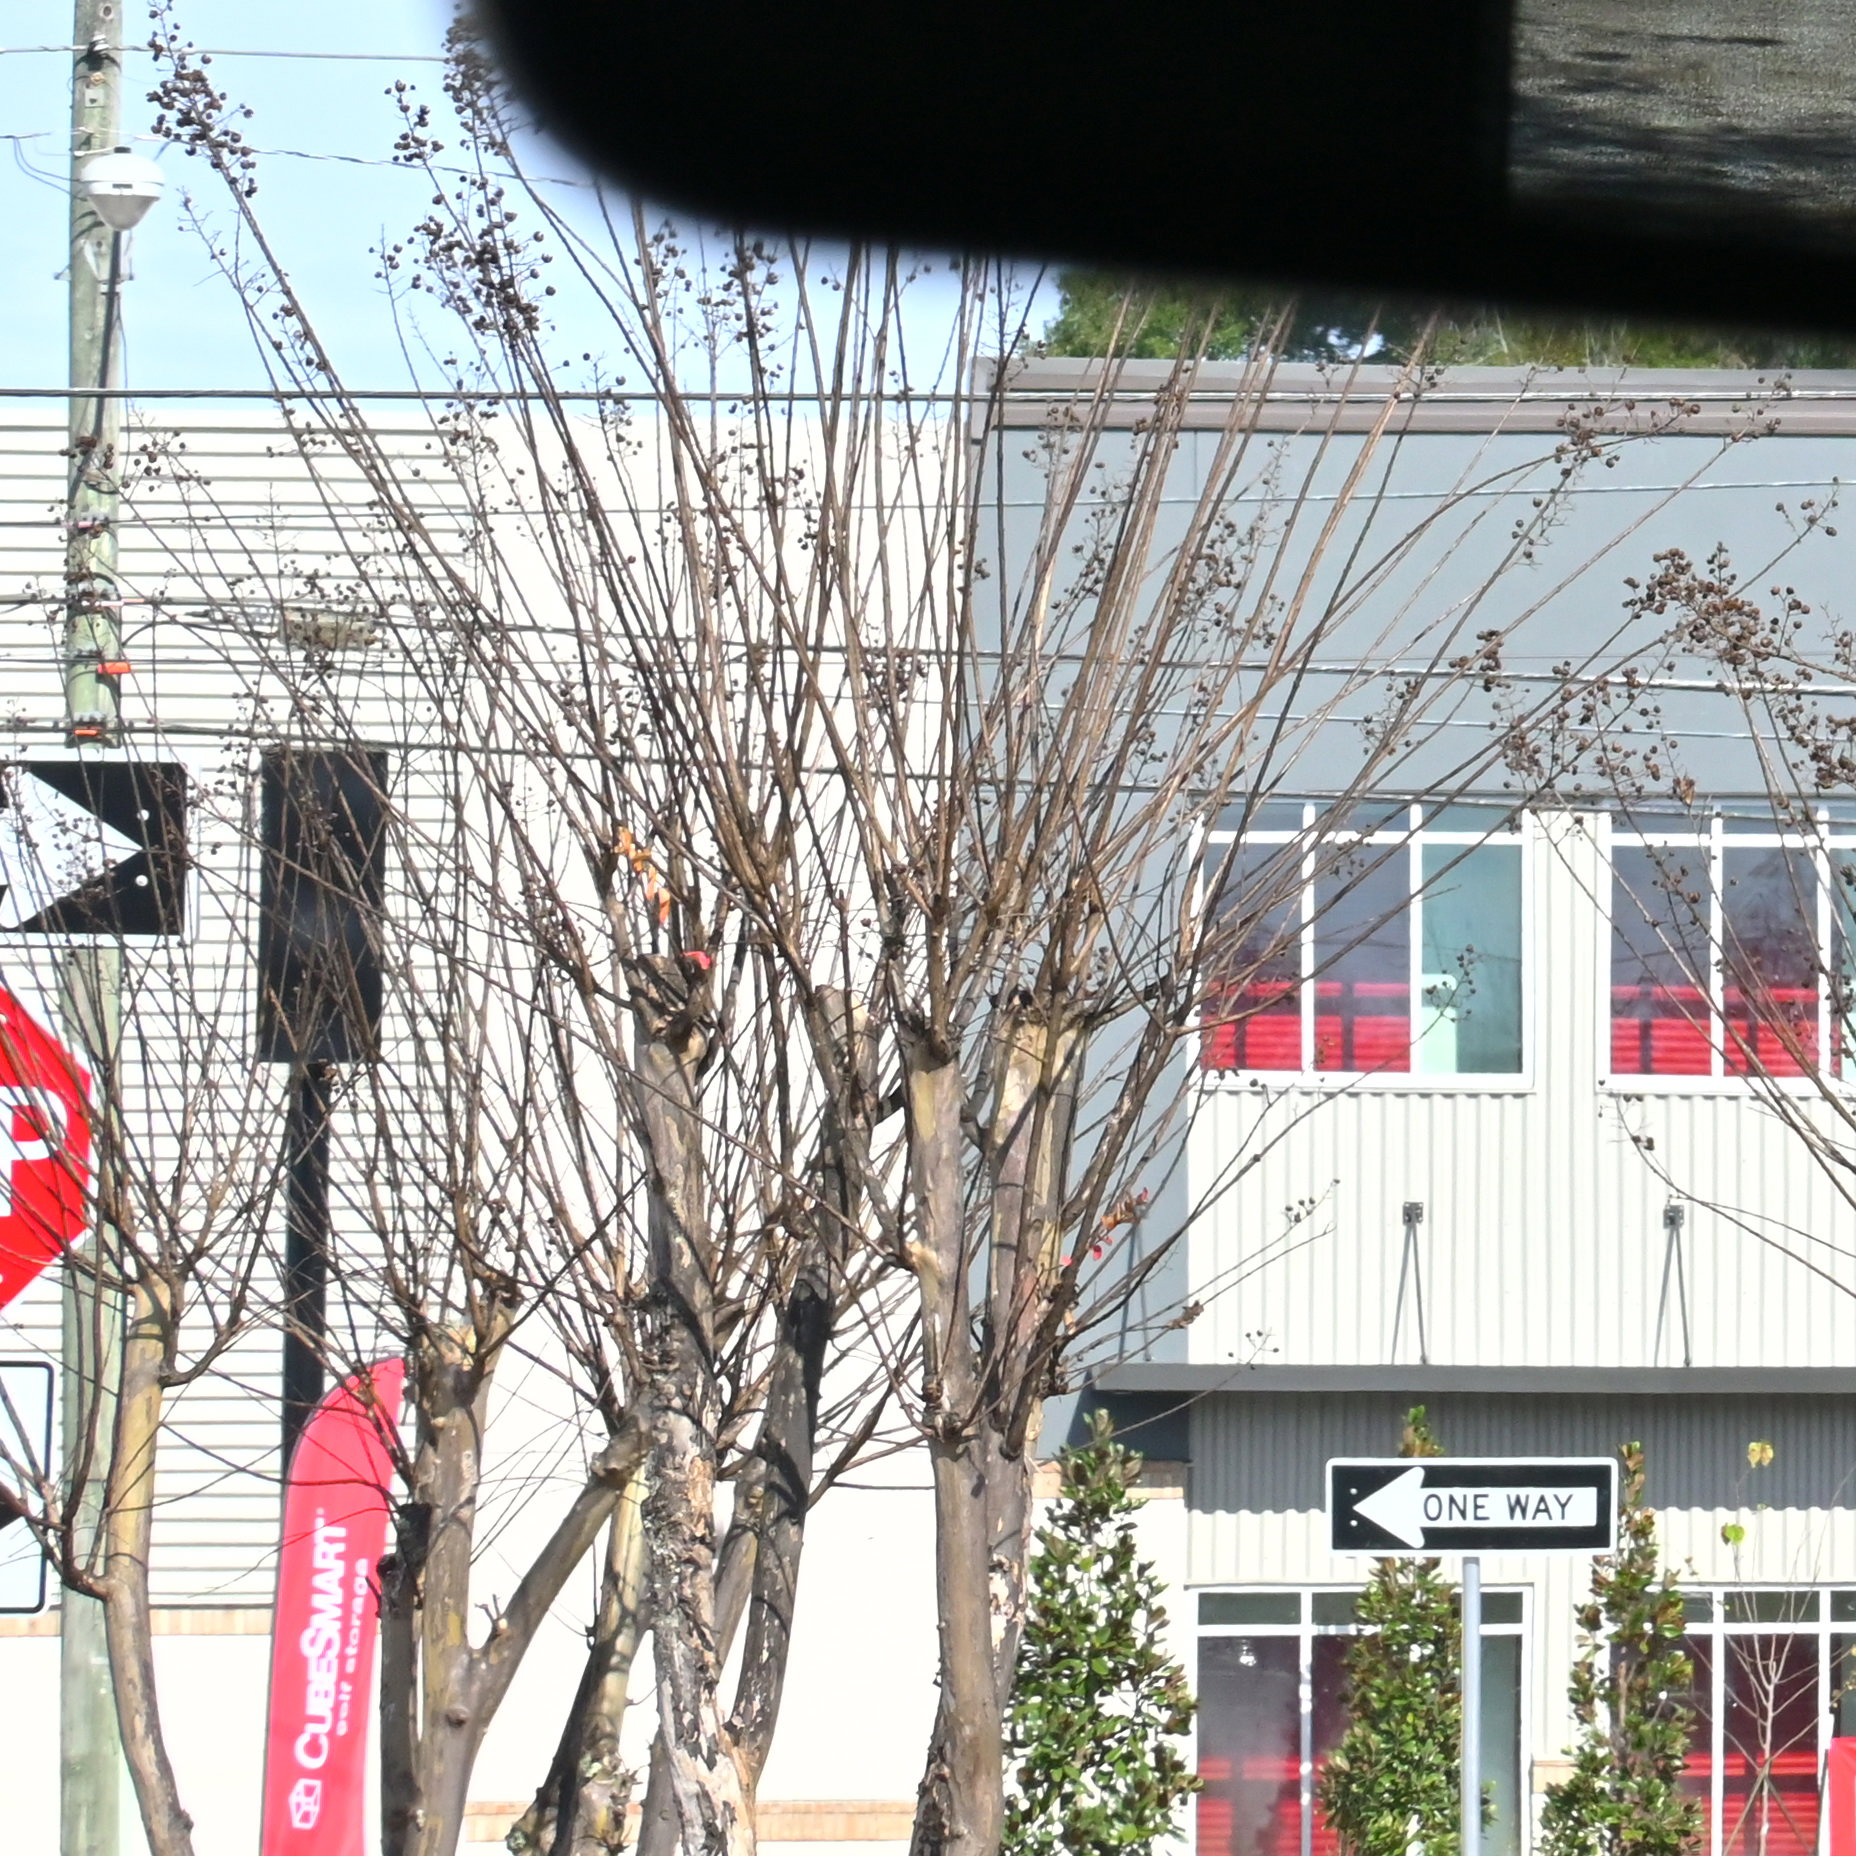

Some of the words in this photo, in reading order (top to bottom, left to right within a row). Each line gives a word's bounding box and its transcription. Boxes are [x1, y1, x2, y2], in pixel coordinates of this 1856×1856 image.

[1423, 1494, 1490, 1521] ONE
[1506, 1494, 1573, 1521] WAY
[336, 1681, 353, 1736] self
[345, 1558, 369, 1673] storage
